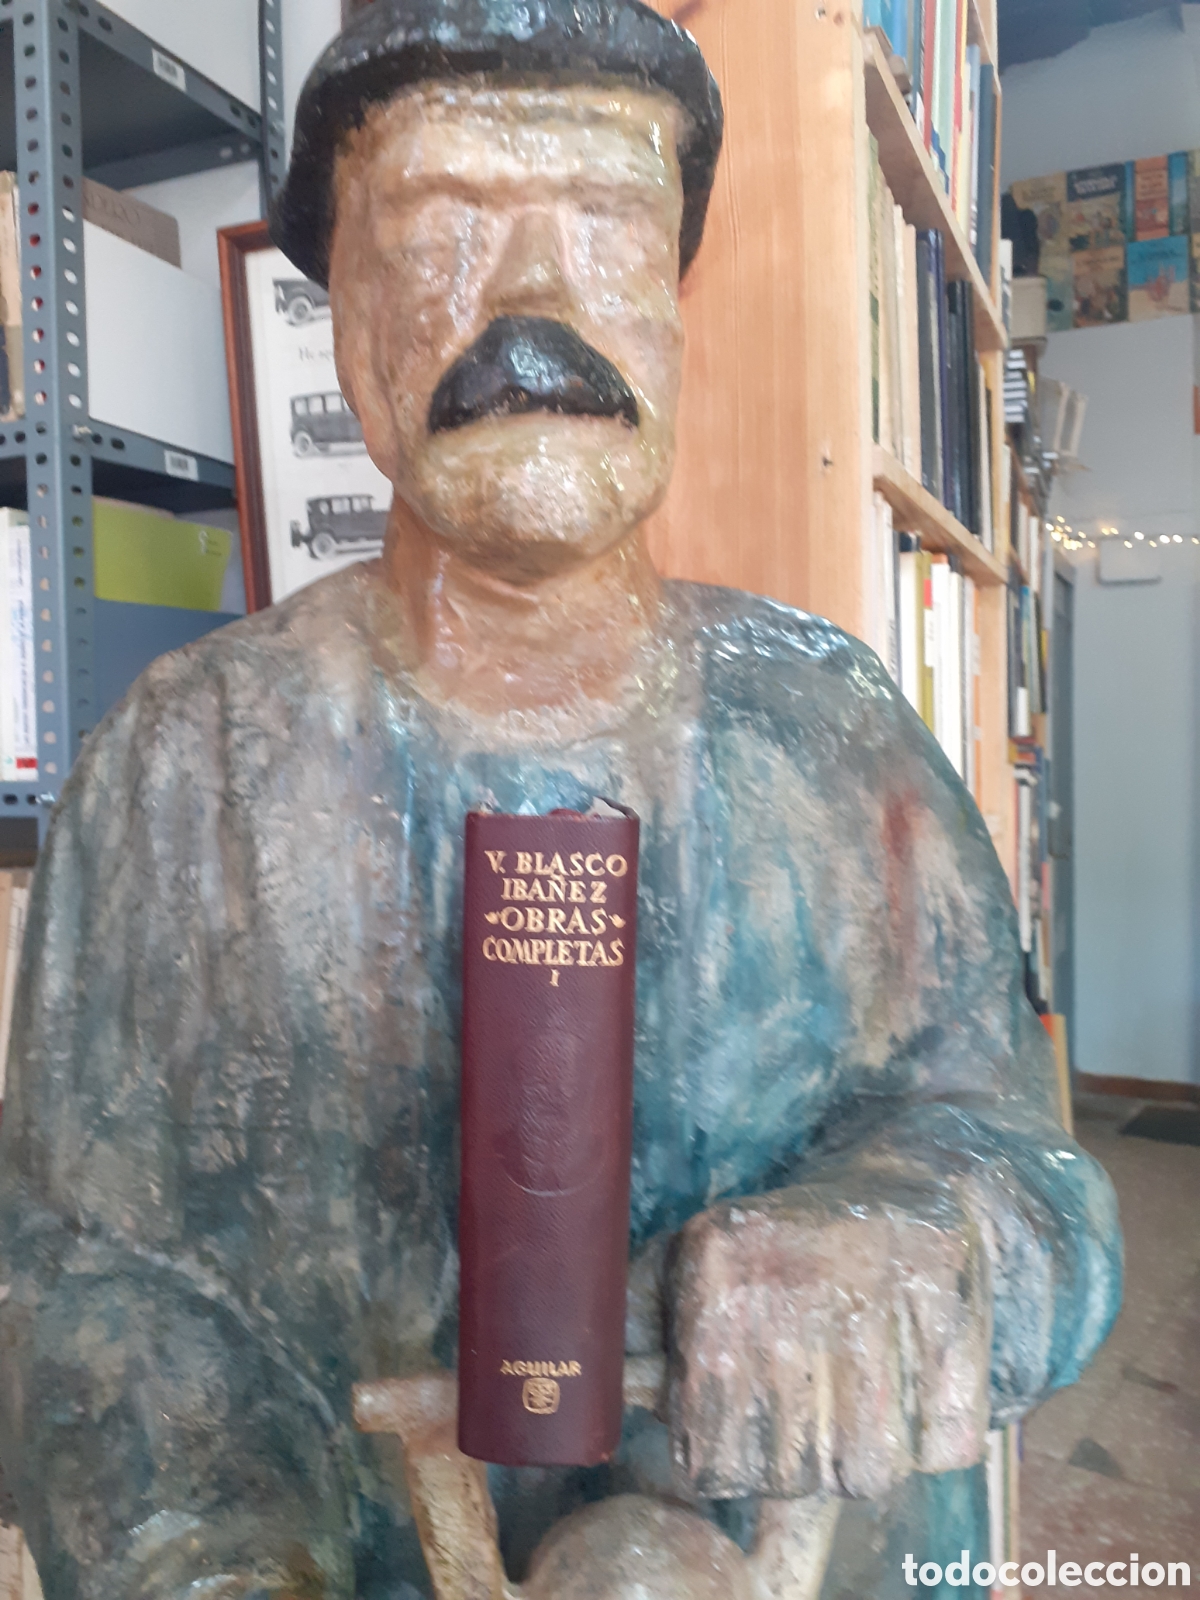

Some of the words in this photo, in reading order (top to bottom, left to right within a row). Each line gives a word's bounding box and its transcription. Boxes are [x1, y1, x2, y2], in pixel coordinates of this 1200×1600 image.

[484, 850, 507, 874] V.
[514, 851, 628, 877] BLASCO
[501, 874, 608, 904] IBAÑEZ
[500, 906, 608, 936] OBRAS
[482, 935, 626, 967] COMPLETAS
[500, 1359, 582, 1377] AGUILAR
